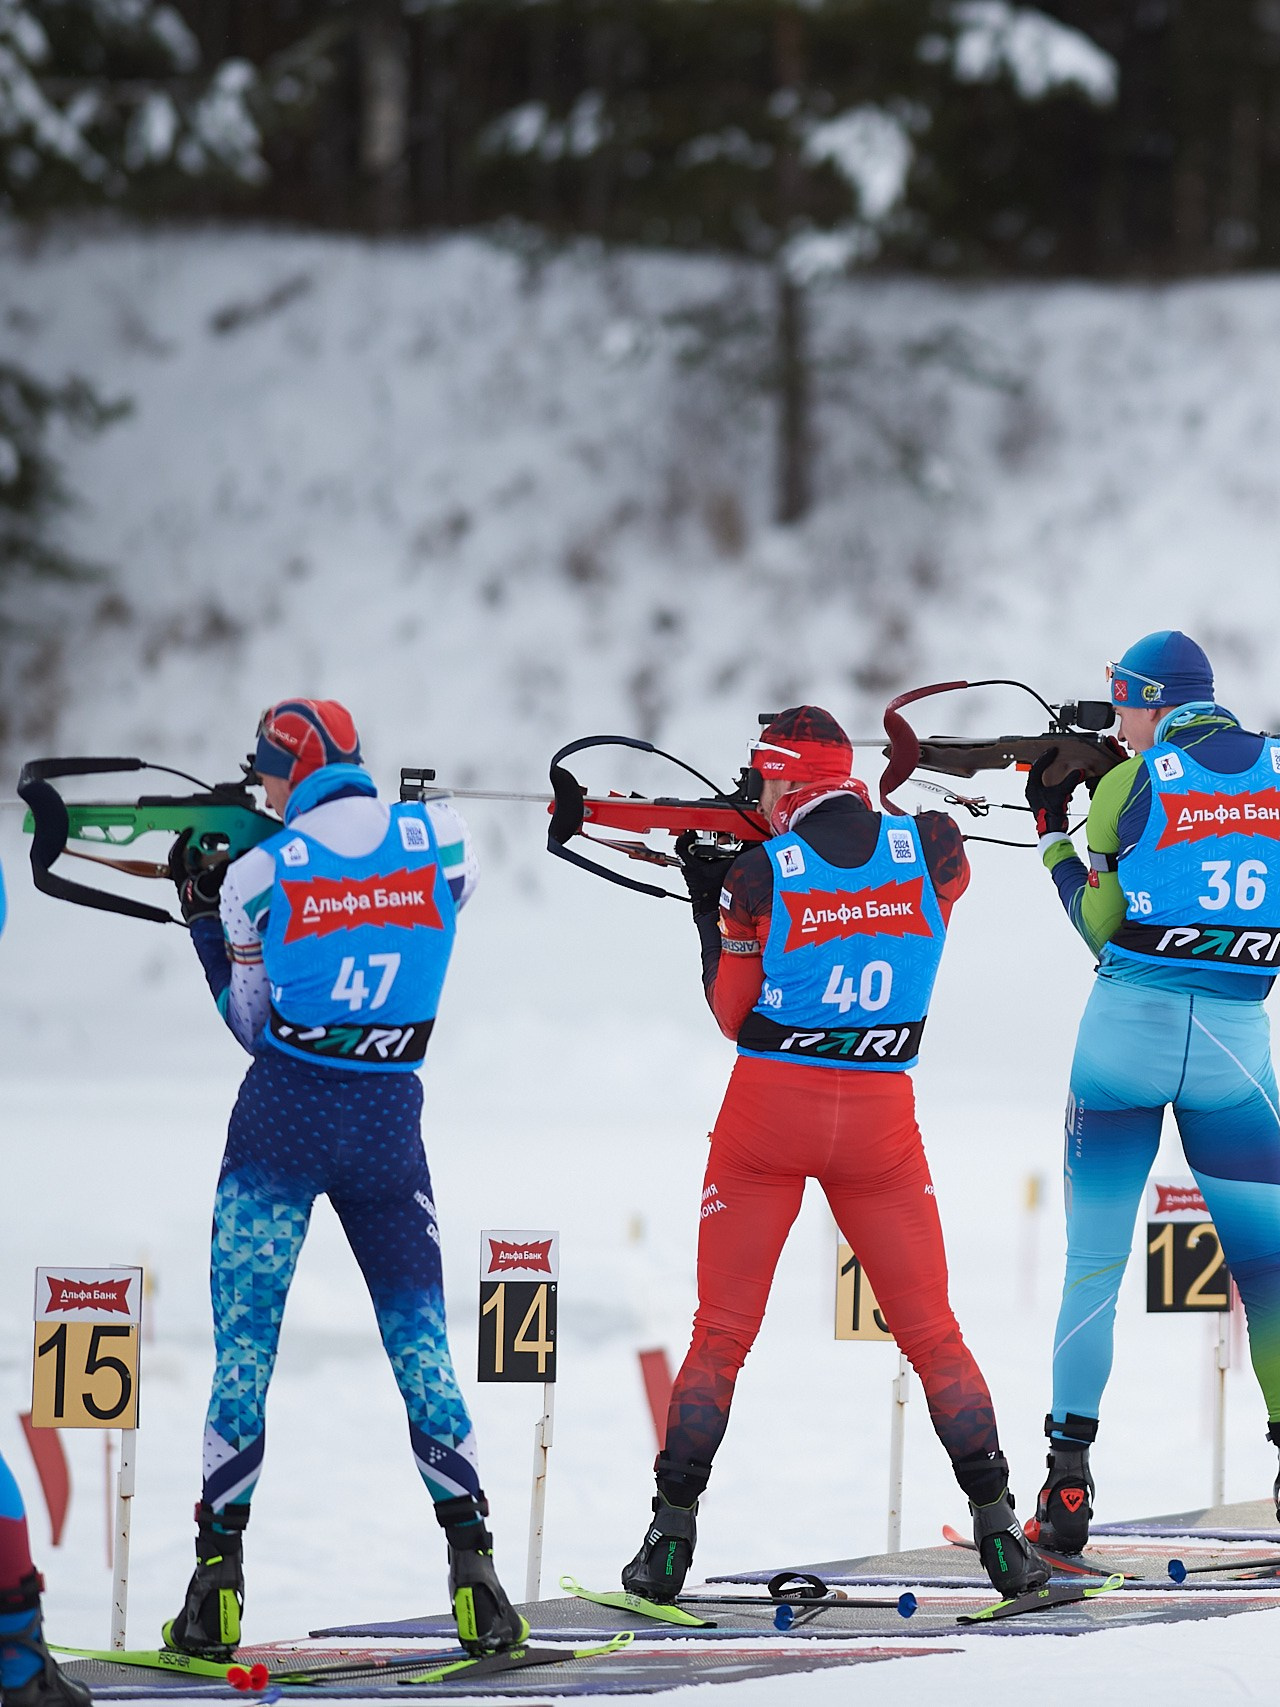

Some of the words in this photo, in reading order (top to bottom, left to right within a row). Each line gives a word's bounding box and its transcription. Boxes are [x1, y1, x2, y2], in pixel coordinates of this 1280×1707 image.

[1177, 804, 1241, 826] Альфа
[893, 839, 910, 849] 2024
[896, 849, 912, 858] 2025
[1199, 860, 1268, 910] 36
[302, 891, 371, 916] Альфа
[374, 888, 425, 909] Банк
[801, 903, 862, 926] Альфа
[865, 900, 914, 921] Банк
[1126, 891, 1153, 915] 36
[331, 952, 401, 1011] 47
[822, 960, 893, 1013] 40
[779, 1027, 910, 1057] PARI
[1075, 1098, 1085, 1158] BIATHLON
[499, 1250, 522, 1262] Альфа
[524, 1251, 542, 1260] Банк
[1149, 1223, 1228, 1306] 12
[60, 1289, 92, 1301] Альфа
[93, 1289, 117, 1300] Банк
[482, 1282, 554, 1374] 14
[38, 1323, 132, 1420] 15
[665, 1541, 676, 1576] SPINE
[994, 1537, 1008, 1572] SPINE
[158, 1653, 191, 1668] FISCHER
